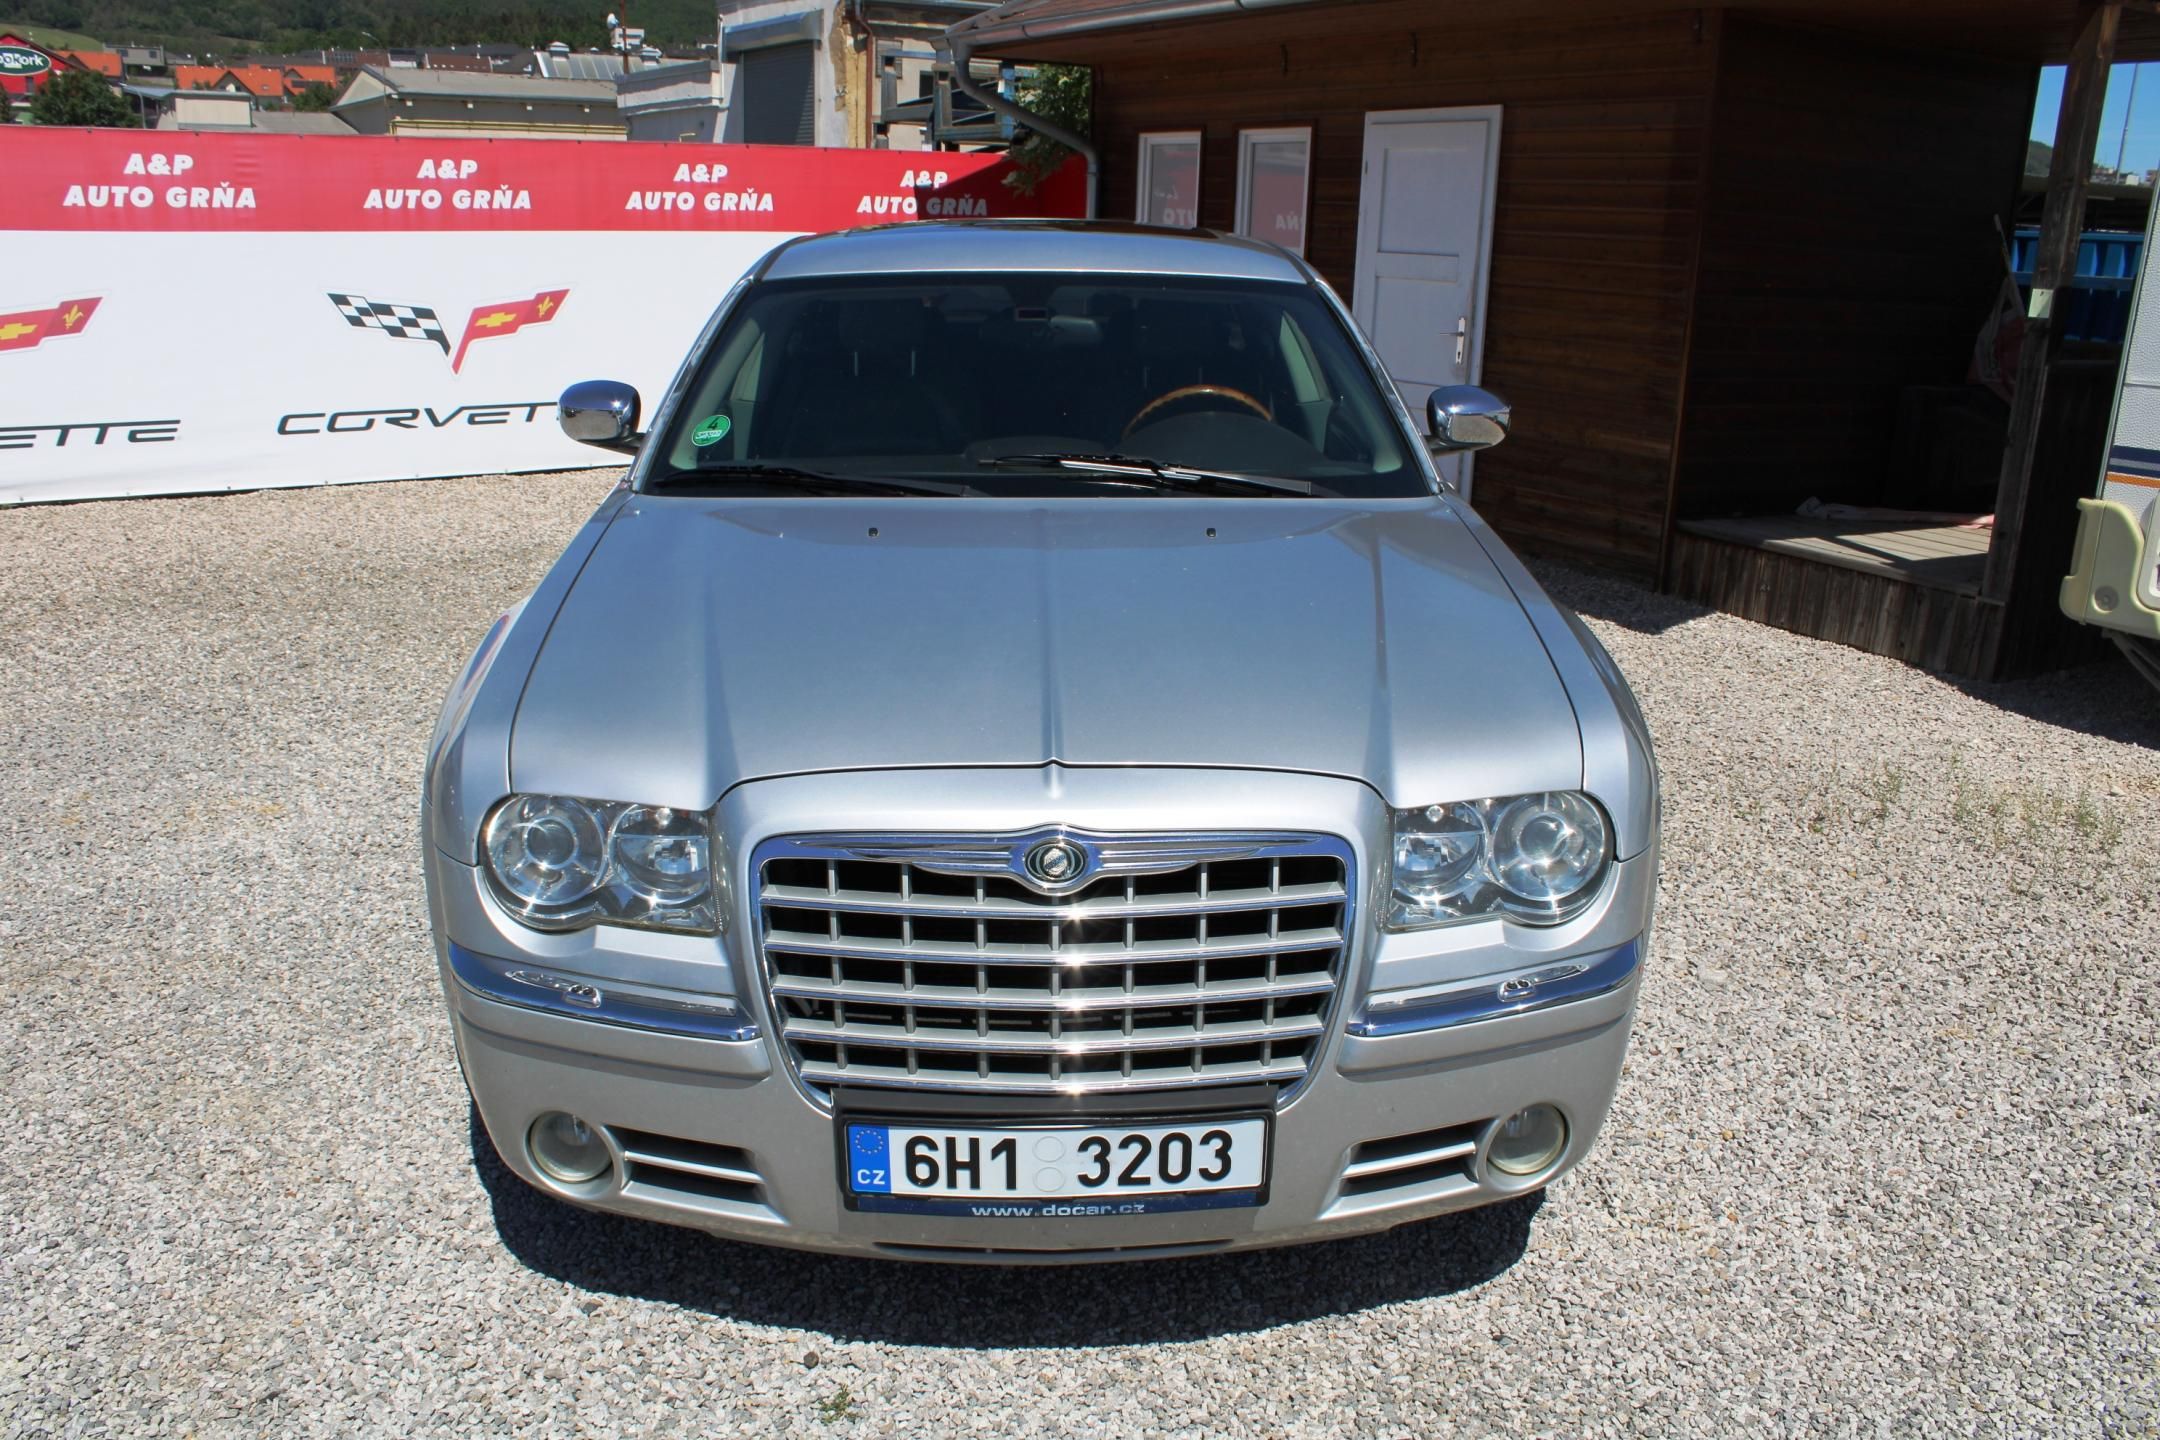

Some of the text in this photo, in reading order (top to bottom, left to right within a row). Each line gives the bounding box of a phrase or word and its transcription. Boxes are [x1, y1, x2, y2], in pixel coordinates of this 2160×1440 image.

[123, 153, 194, 175] A&P
[416, 159, 478, 179] A&P
[673, 163, 728, 183] A&P
[900, 170, 948, 188] A&P
[63, 181, 257, 208] AUTO GRŇA
[363, 184, 531, 209] AUTO GRŇA
[625, 187, 774, 211] AUTO GRŇA
[856, 194, 987, 216] AUTO GRŇA
[905, 1129, 1233, 1191] 6H1 3203
[857, 1169, 886, 1185] CZ
[971, 1203, 1145, 1217] www.docar.cz
